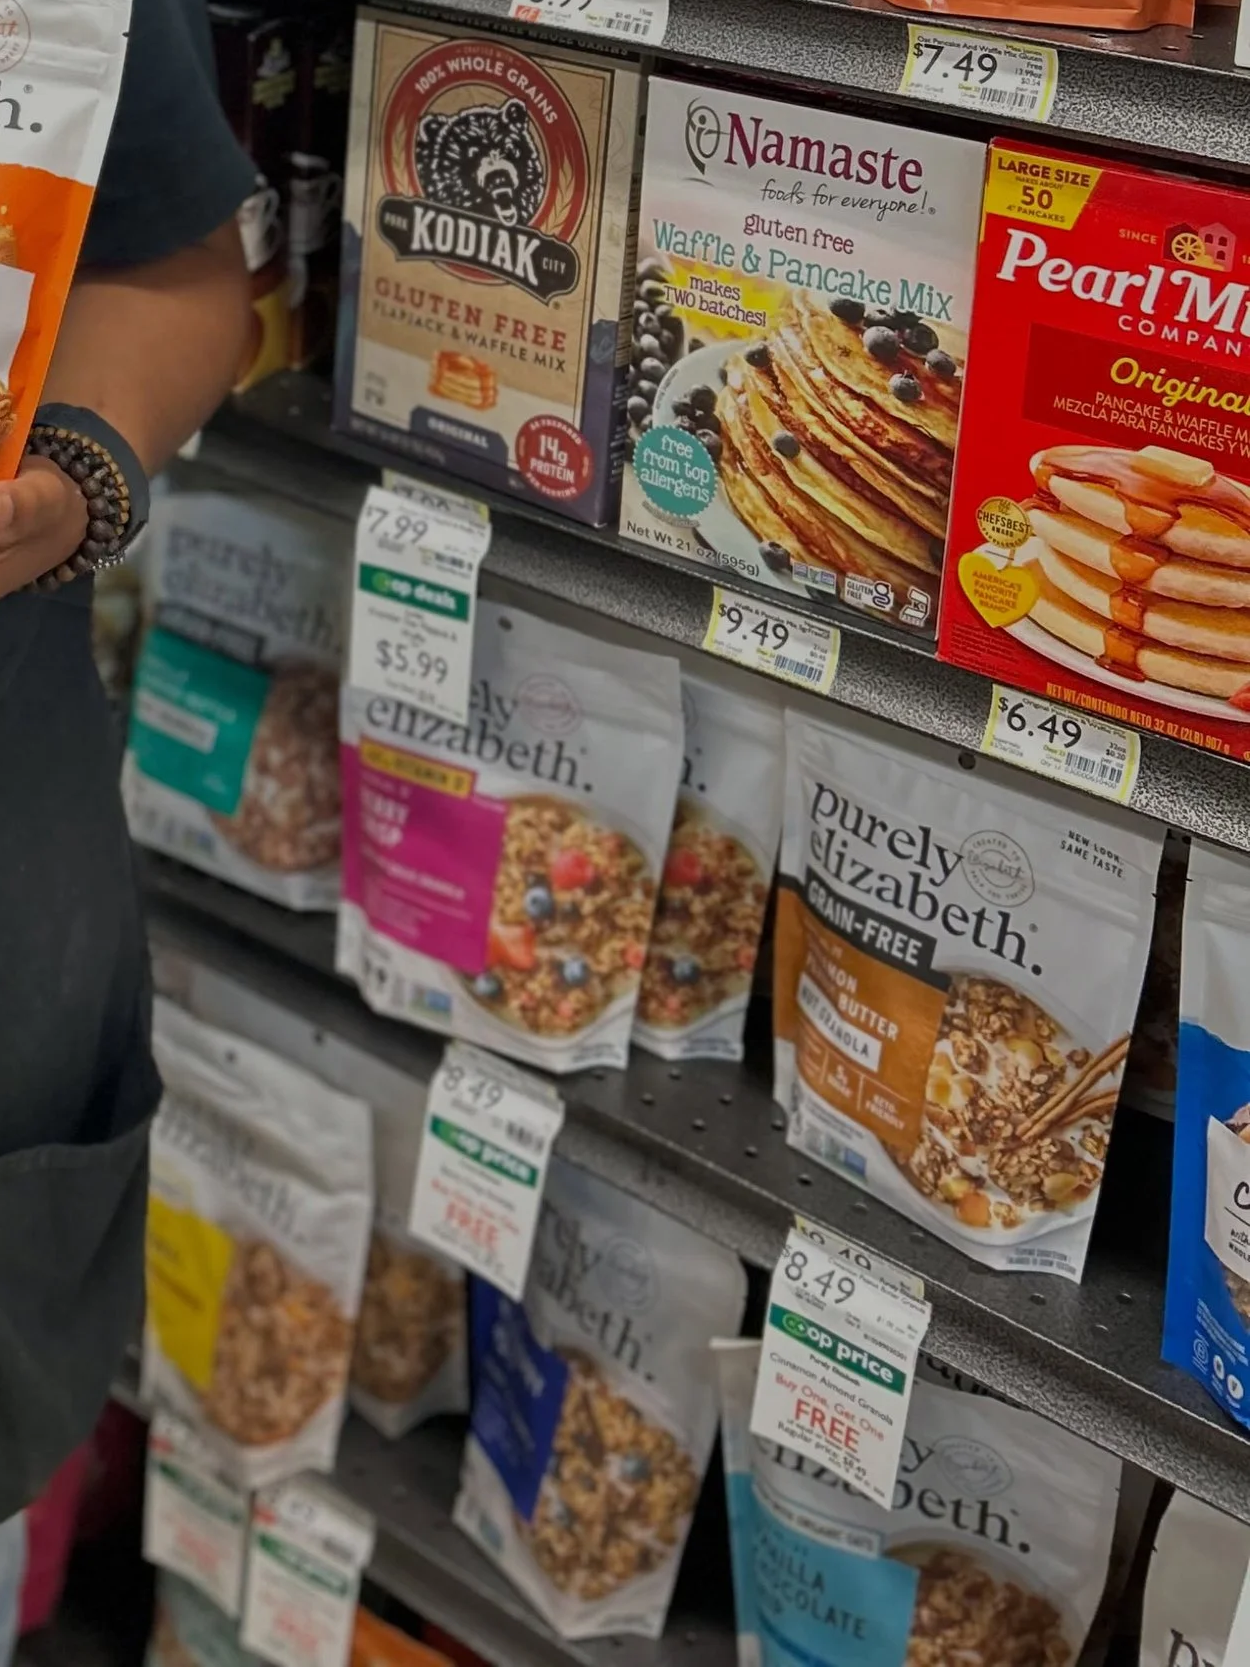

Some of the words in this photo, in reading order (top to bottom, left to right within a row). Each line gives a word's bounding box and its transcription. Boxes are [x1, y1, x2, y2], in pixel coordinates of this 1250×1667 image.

[913, 42, 997, 84] $7.49
[414, 64, 446, 95] 100%
[446, 56, 504, 75] WHOLE
[505, 69, 558, 124] GRAINS
[724, 112, 923, 194] Namaste
[997, 158, 1053, 180] LARGE
[1054, 170, 1090, 187] SIZE
[1021, 187, 1053, 210] 50
[410, 205, 541, 286] KODIAK
[542, 256, 566, 275] CITY
[743, 214, 808, 245] gluten
[812, 227, 855, 255] free
[1119, 229, 1157, 244] SINCE
[653, 219, 735, 267] Waffle
[742, 245, 762, 273] &
[767, 248, 892, 306] Pancake
[899, 279, 954, 321] Mix
[690, 275, 741, 301] makes
[996, 229, 1165, 315] Pearl
[374, 276, 483, 329] GLUTEN
[495, 315, 567, 353] FREE
[663, 285, 695, 308] TWO
[698, 295, 766, 326] batches!
[1118, 315, 1242, 357] COMPAN
[1111, 357, 1250, 414] Origina
[1054, 396, 1107, 421] MEZCLA
[1110, 413, 1146, 431] PARA
[1150, 421, 1224, 450] PANCAKES
[1228, 441, 1238, 453] Y
[1096, 392, 1161, 419] PANCAKE
[1164, 410, 1173, 423] &
[1177, 413, 1233, 439] WAFFLE
[530, 457, 576, 484] PROTEIN
[643, 451, 680, 474] from
[684, 463, 709, 484] top
[661, 435, 693, 460] free
[640, 467, 710, 503] allergens
[977, 510, 1030, 534] CHEFSBEST
[627, 521, 650, 539] Net
[653, 531, 673, 546] Wt
[676, 538, 691, 552] 21
[696, 548, 713, 558] oz
[716, 551, 760, 576] (595g)
[718, 604, 789, 650] $9.49
[376, 639, 449, 684] $5.99
[998, 697, 1082, 748] $6.49
[1046, 683, 1061, 699] NET
[1063, 689, 1128, 720] WT/CONTENIDO
[1130, 710, 1151, 728] NETO
[1153, 718, 1165, 731] 32
[1166, 723, 1178, 737] OZ
[1180, 725, 1203, 745] (2LB)
[1204, 735, 1223, 750] 907
[812, 782, 963, 887] purely
[808, 880, 922, 966] GRAIN-FREE
[810, 830, 1043, 976] elizabeth.
[838, 993, 899, 1041] BUTTER
[782, 1245, 855, 1305] $8.49
[836, 1340, 894, 1383] price
[770, 1352, 817, 1382] Cinnamon
[820, 1376, 855, 1403] Almond
[858, 1398, 893, 1426] Granola
[795, 1399, 860, 1453] FREE
